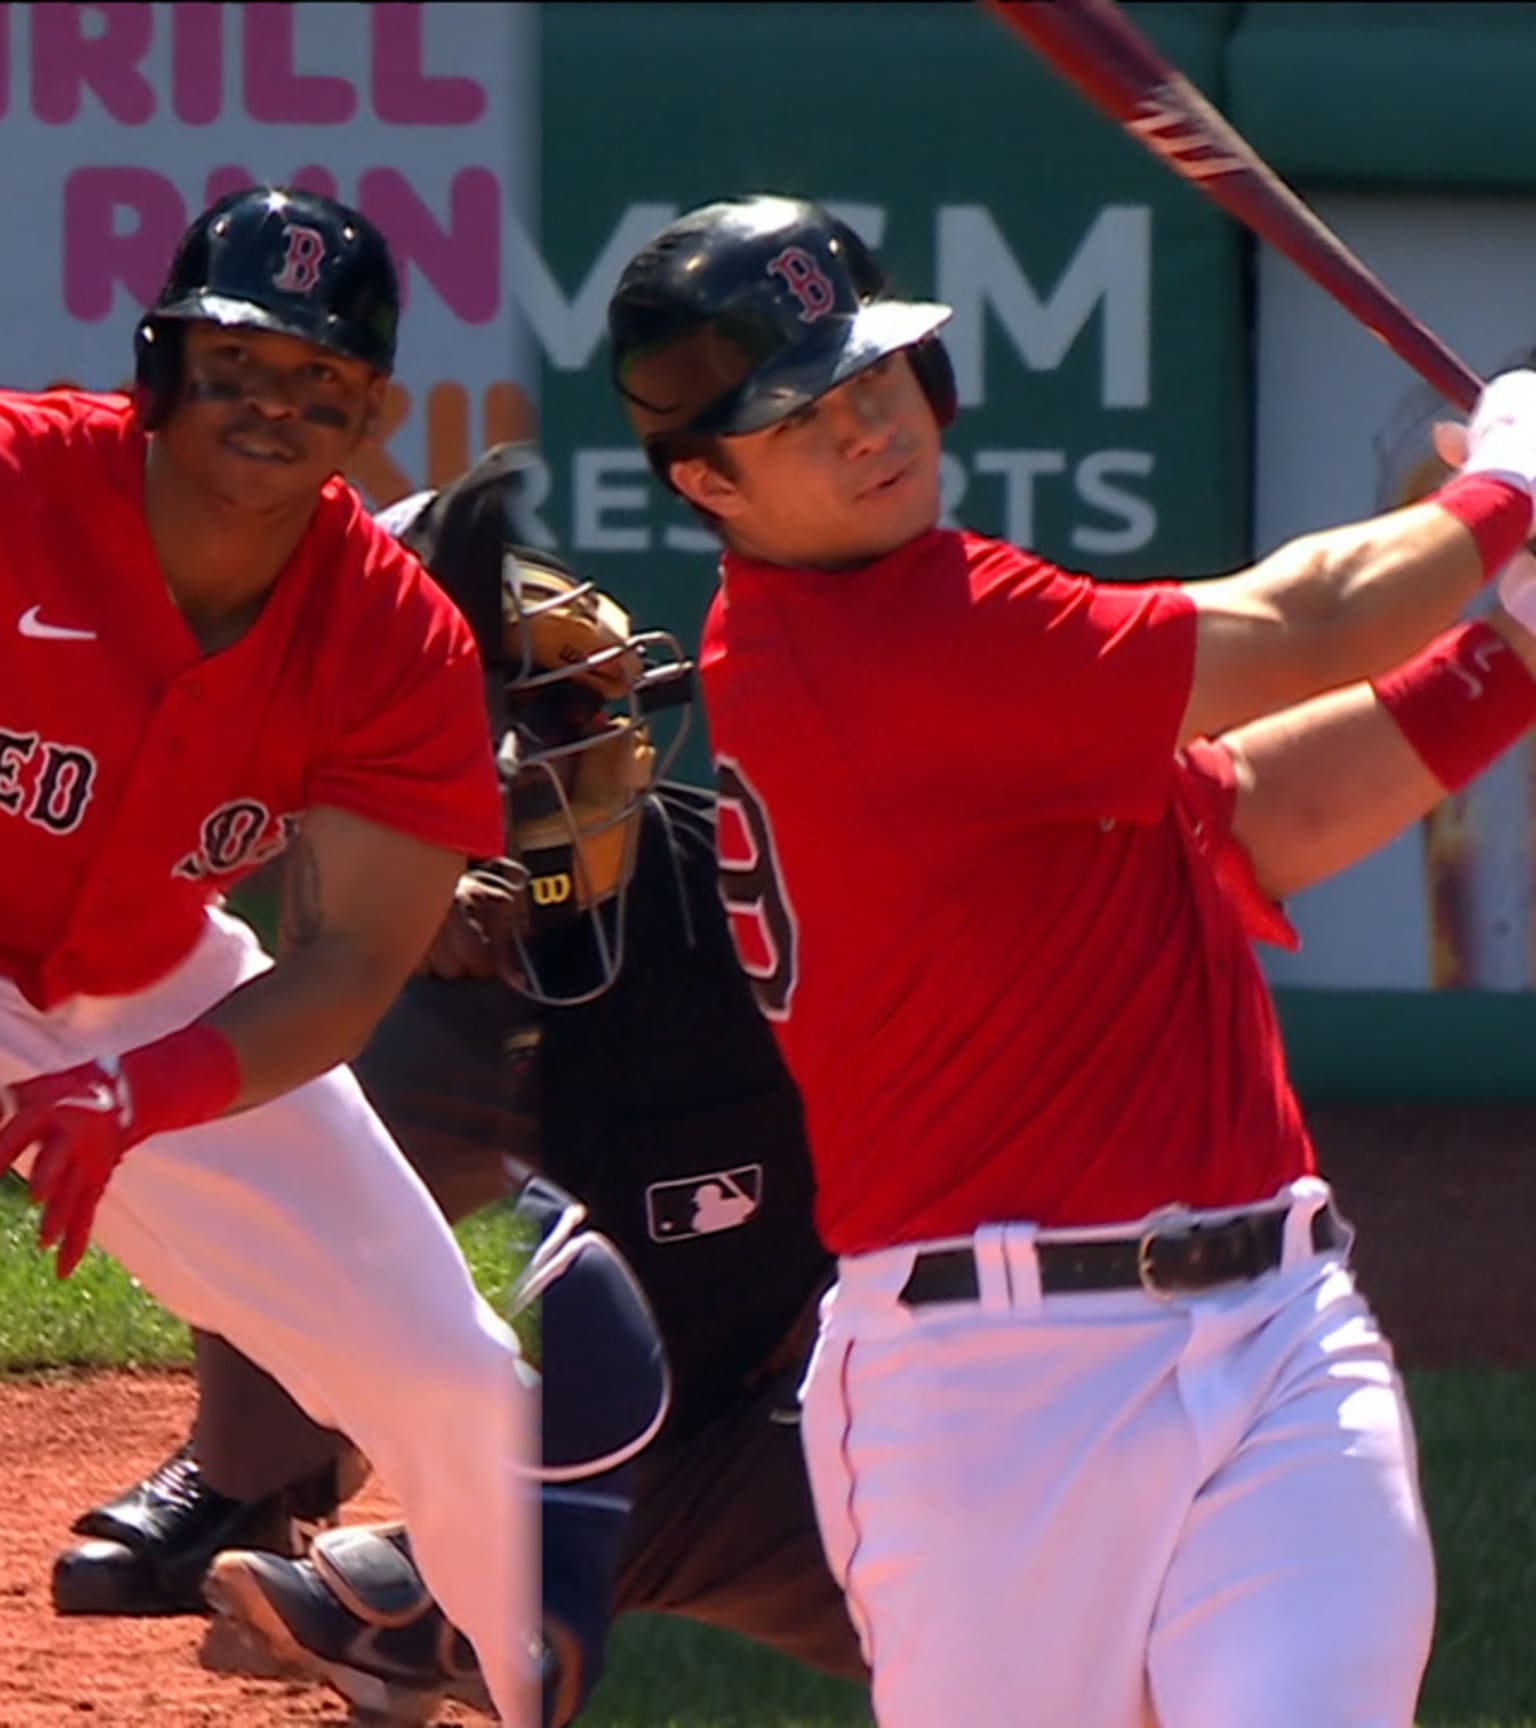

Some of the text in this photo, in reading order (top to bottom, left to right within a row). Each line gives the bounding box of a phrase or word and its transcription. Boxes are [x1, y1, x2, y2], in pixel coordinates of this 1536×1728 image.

[62, 164, 501, 326] RN
[272, 225, 325, 293] B
[766, 246, 835, 323] B
